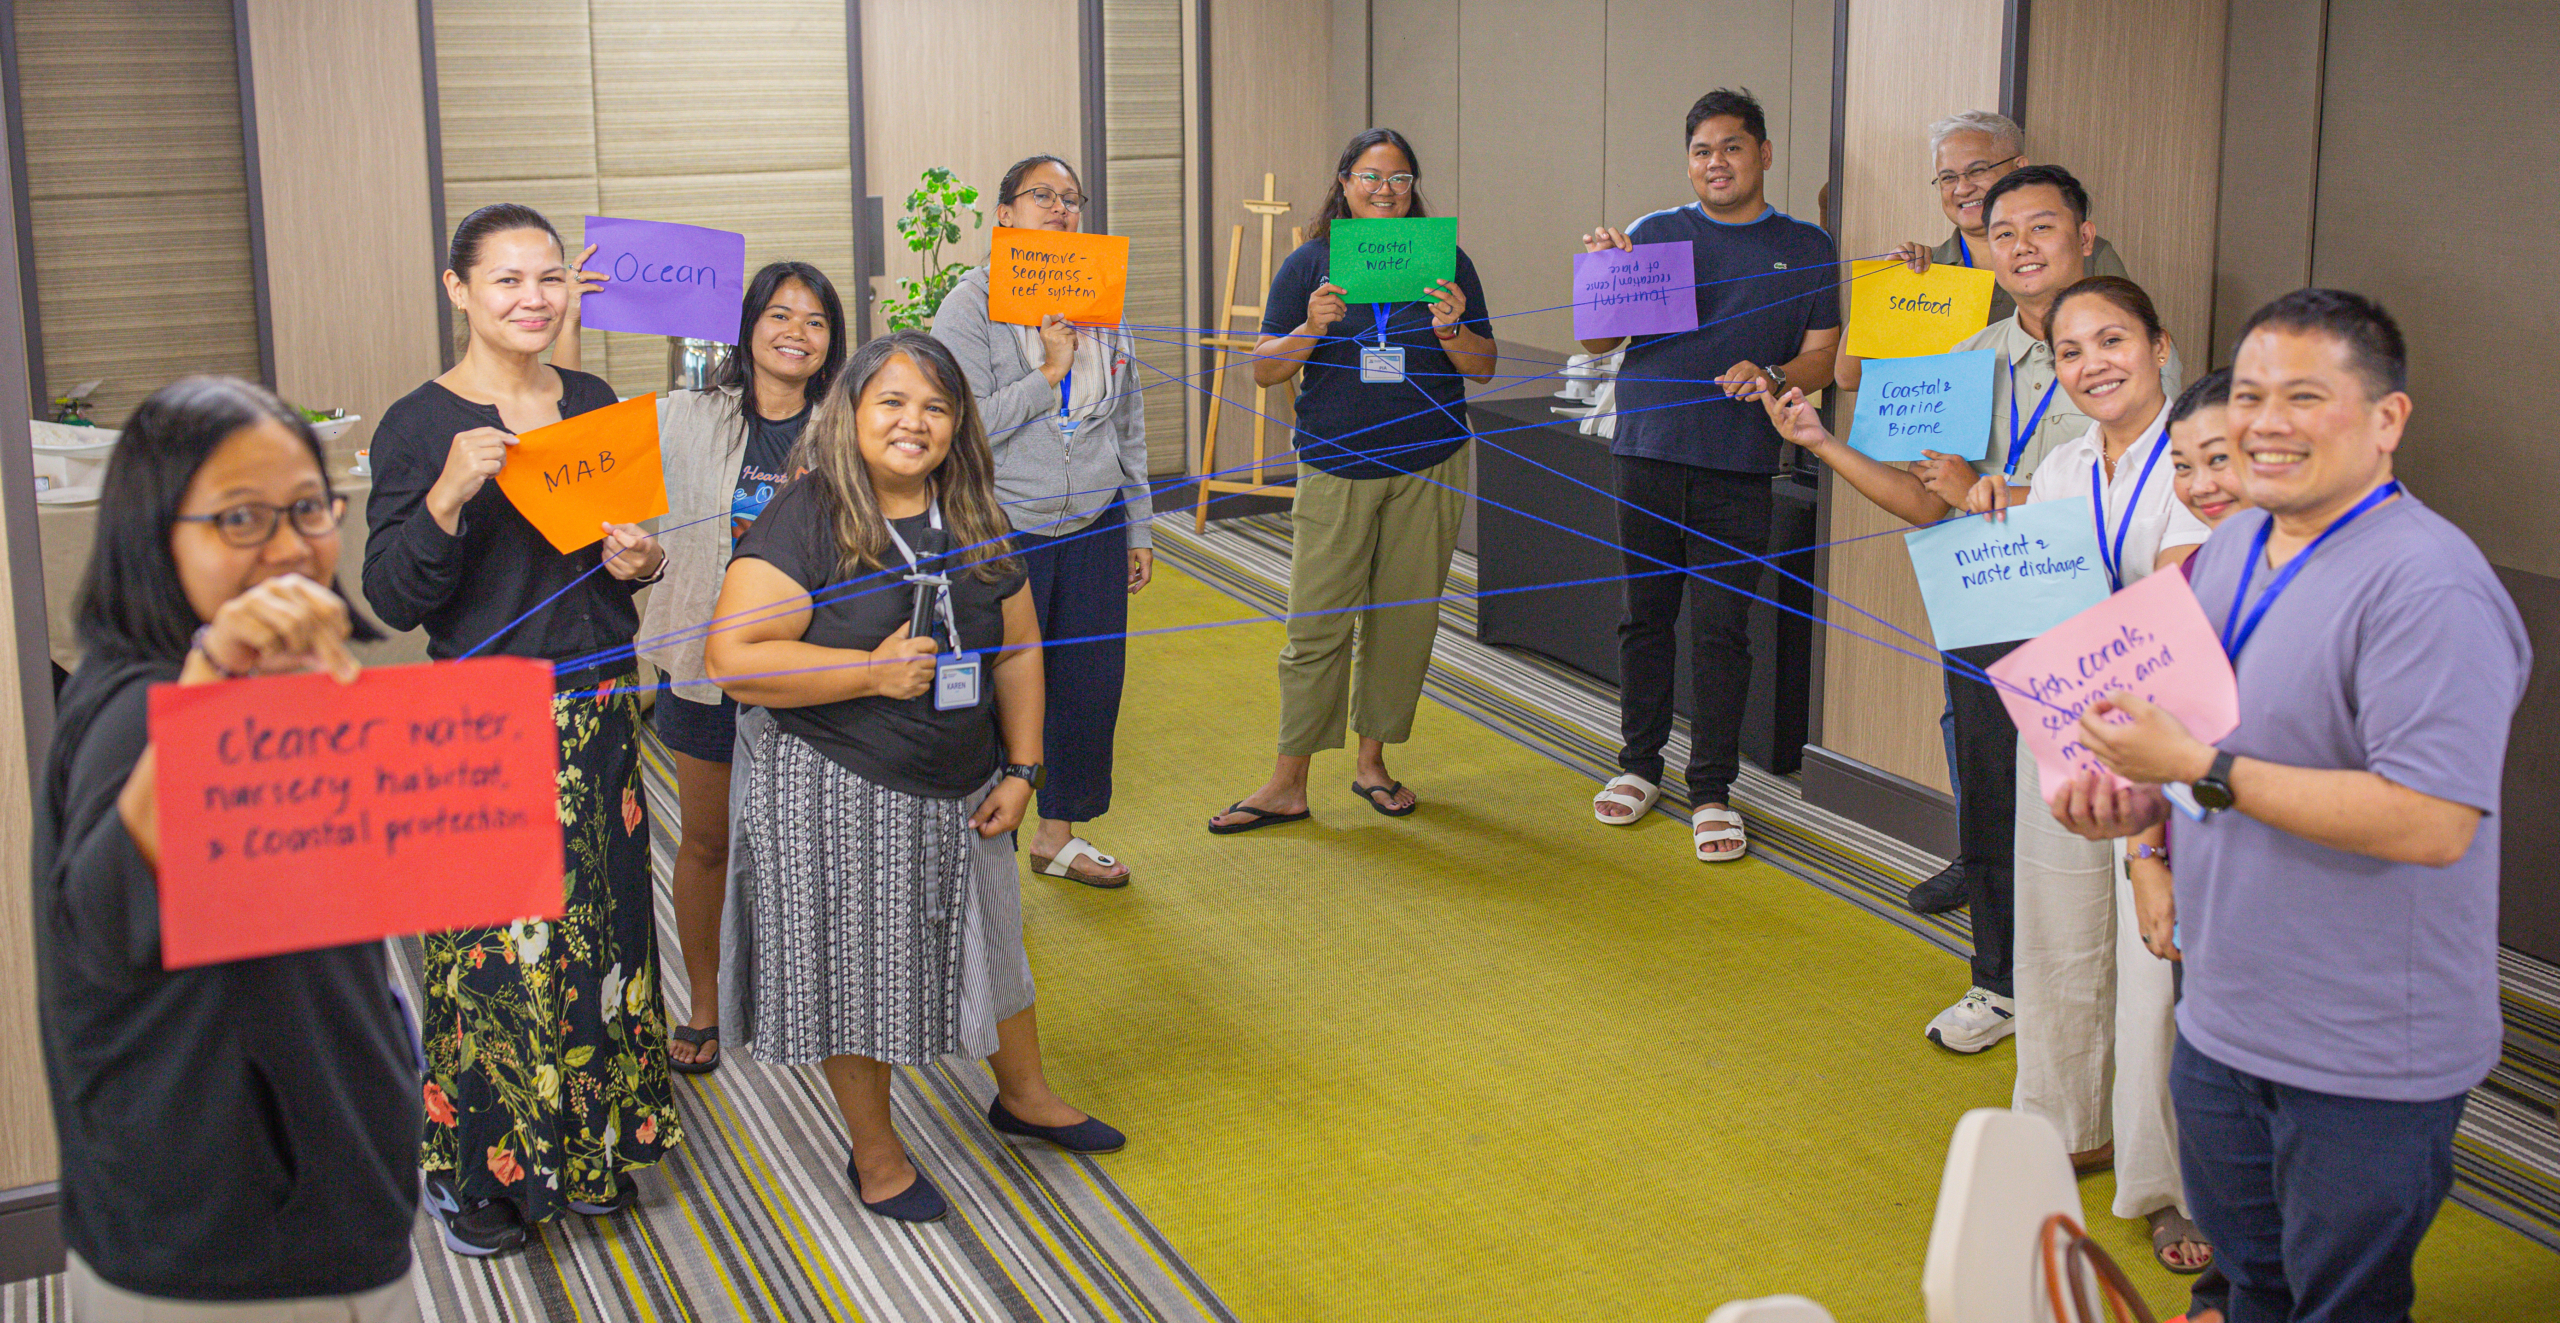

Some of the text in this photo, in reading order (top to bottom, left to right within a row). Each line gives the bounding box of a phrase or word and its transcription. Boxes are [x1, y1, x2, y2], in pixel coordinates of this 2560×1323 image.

[613, 252, 717, 290] Ocean
[1366, 256, 1412, 271] water
[1608, 260, 1660, 274] of place
[1012, 284, 1096, 302] reef system
[1889, 292, 1952, 317] seafood
[1882, 378, 1940, 399] Coastal
[1888, 421, 1943, 437] Biome
[543, 450, 616, 494] MAB
[742, 464, 788, 484] Heart
[1955, 533, 2029, 567] nutrient
[1961, 555, 2091, 589] waste discharge
[2135, 644, 2176, 682] and
[947, 682, 966, 690] KAREN
[217, 714, 388, 766] cleaner
[385, 803, 528, 857] protection
